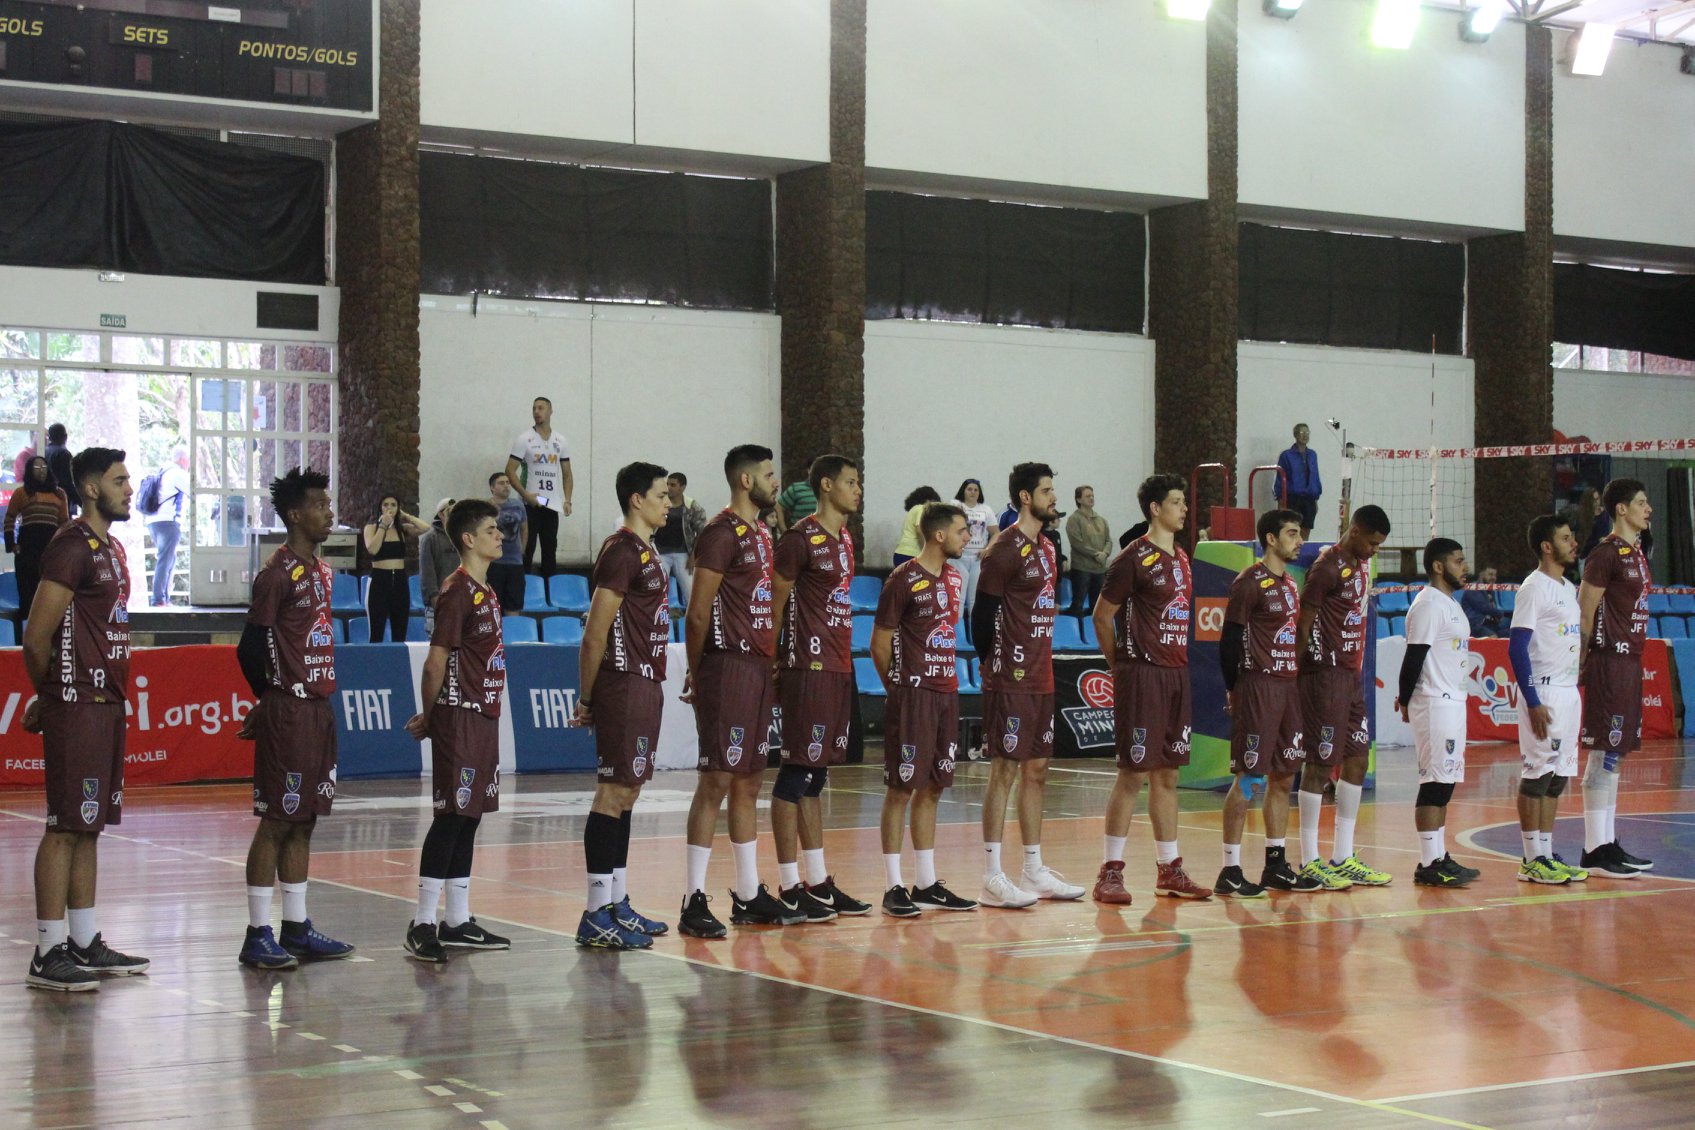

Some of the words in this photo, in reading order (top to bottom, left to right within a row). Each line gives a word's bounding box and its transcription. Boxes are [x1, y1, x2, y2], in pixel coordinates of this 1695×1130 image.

[0, 17, 44, 36] GOLS
[123, 26, 169, 44] SETS
[238, 41, 358, 66] PONTOS/GOLS
[1397, 450, 1412, 459] SKY
[1440, 450, 1456, 458] SKY
[1487, 447, 1502, 457] SKY
[1510, 446, 1526, 456] SKY
[1535, 446, 1550, 454] SKY
[1559, 444, 1575, 454] SKY
[1584, 442, 1600, 452] SKY
[1610, 442, 1626, 451] SKY
[1634, 441, 1652, 450] SKY
[1661, 440, 1677, 449] SKY
[539, 480, 553, 491] 18
[827, 616, 841, 627] JF
[1630, 623, 1642, 633] JF
[810, 636, 821, 655] 8
[1160, 634, 1175, 645] JF
[1343, 641, 1354, 652] JF
[107, 645, 122, 660] JF
[1013, 646, 1025, 662] 5
[925, 665, 940, 677] JF
[1273, 660, 1285, 671] JF
[306, 668, 320, 682] JF
[1541, 676, 1551, 685] 11
[484, 691, 497, 704] JF
[341, 689, 392, 730] FIAT
[529, 689, 576, 728] FIAT
